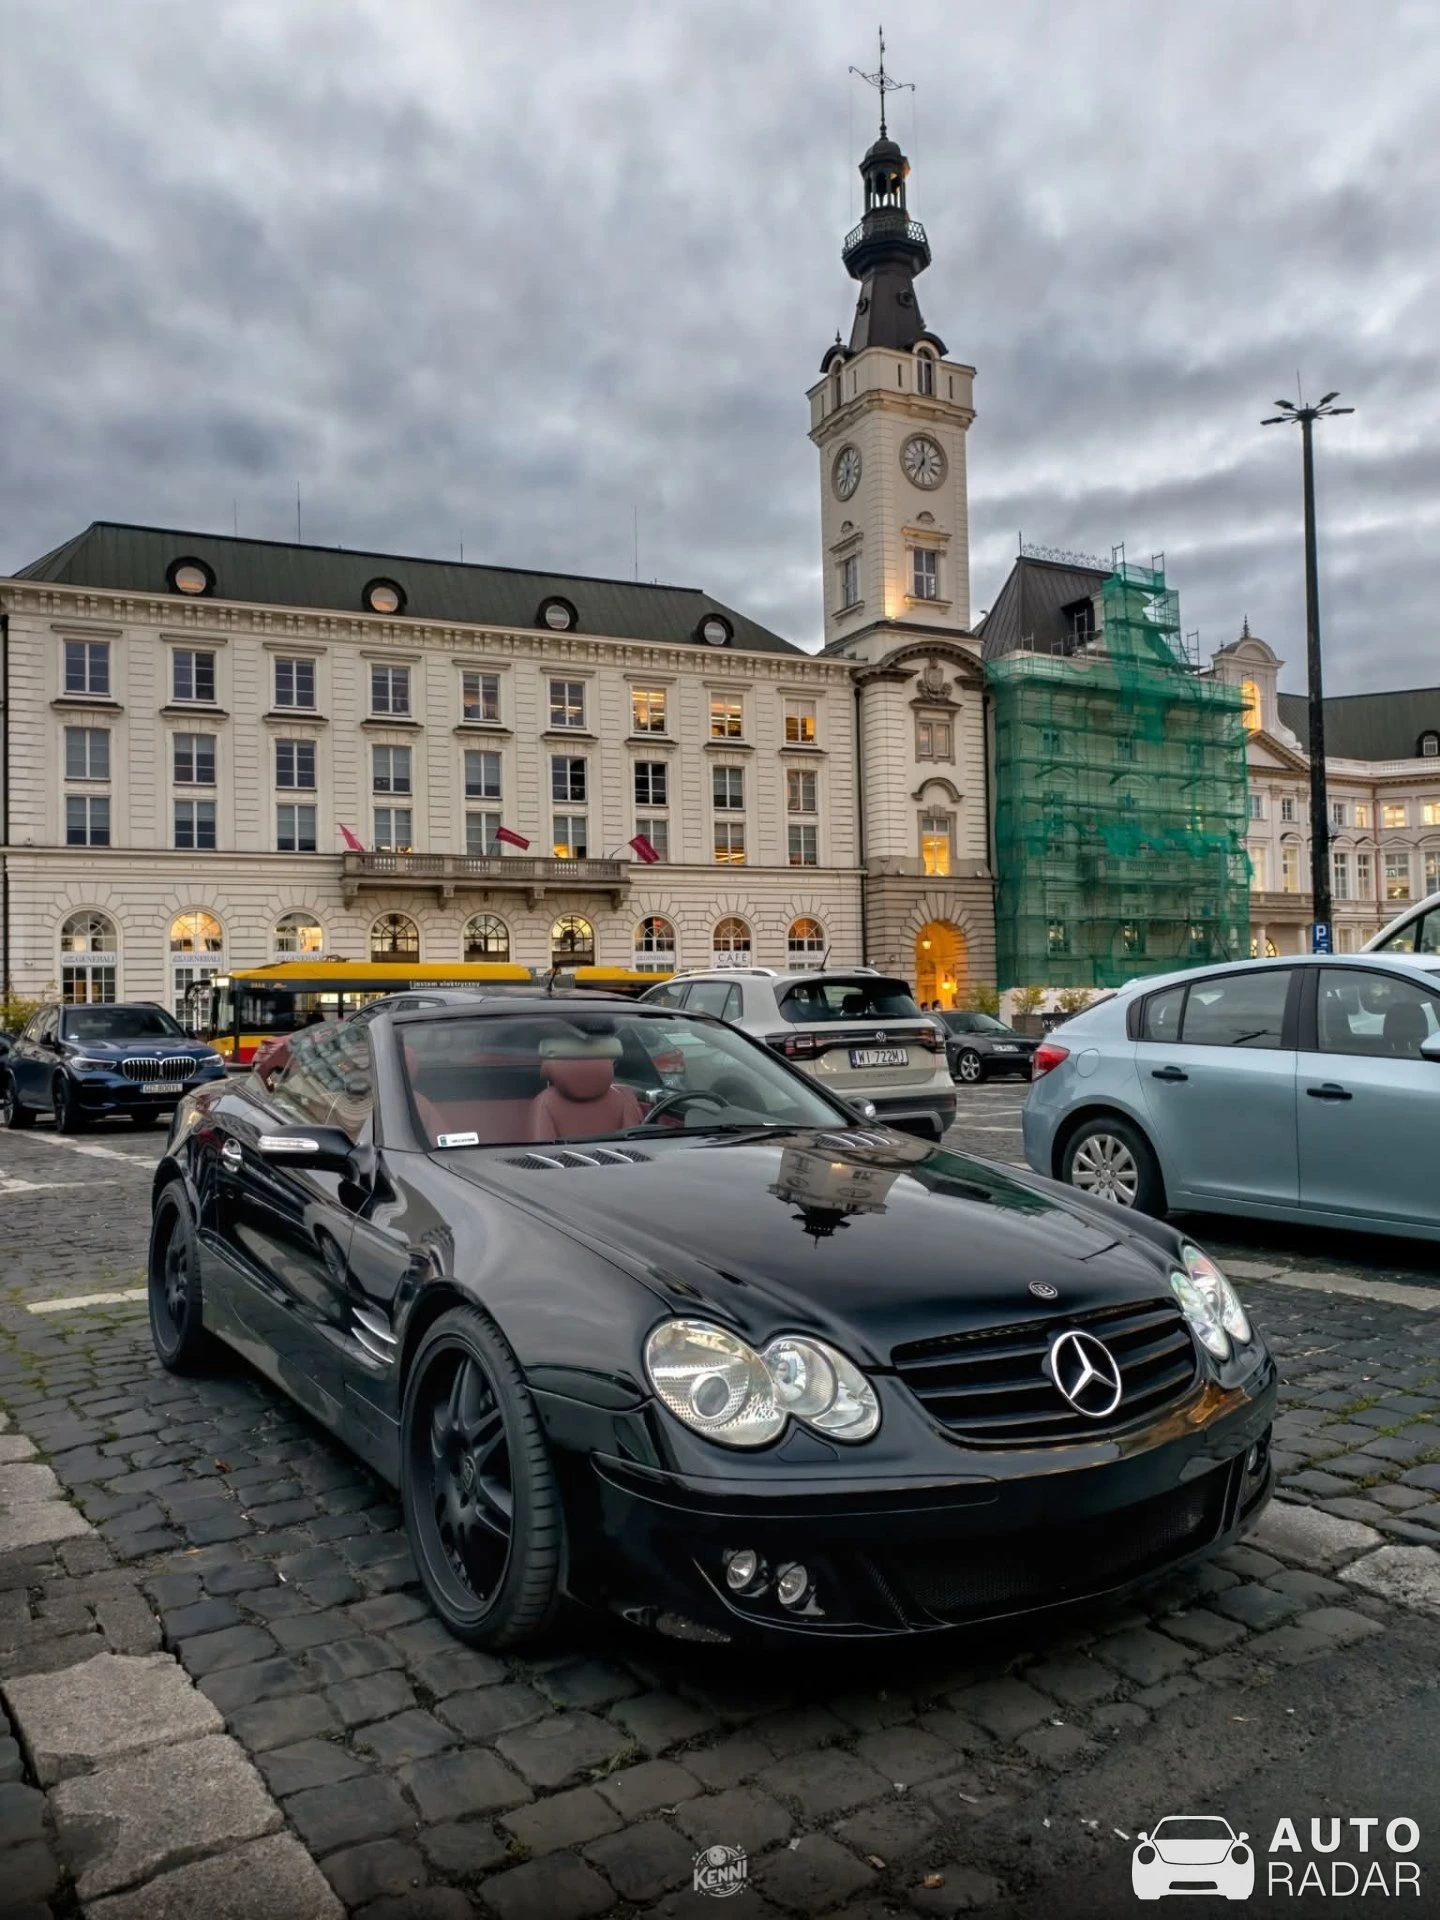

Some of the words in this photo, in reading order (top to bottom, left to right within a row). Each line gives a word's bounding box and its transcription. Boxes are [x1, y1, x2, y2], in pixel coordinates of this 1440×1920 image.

[1316, 925, 1326, 941] P
[857, 1051, 870, 1064] WI
[874, 1049, 904, 1063] 722MJ
